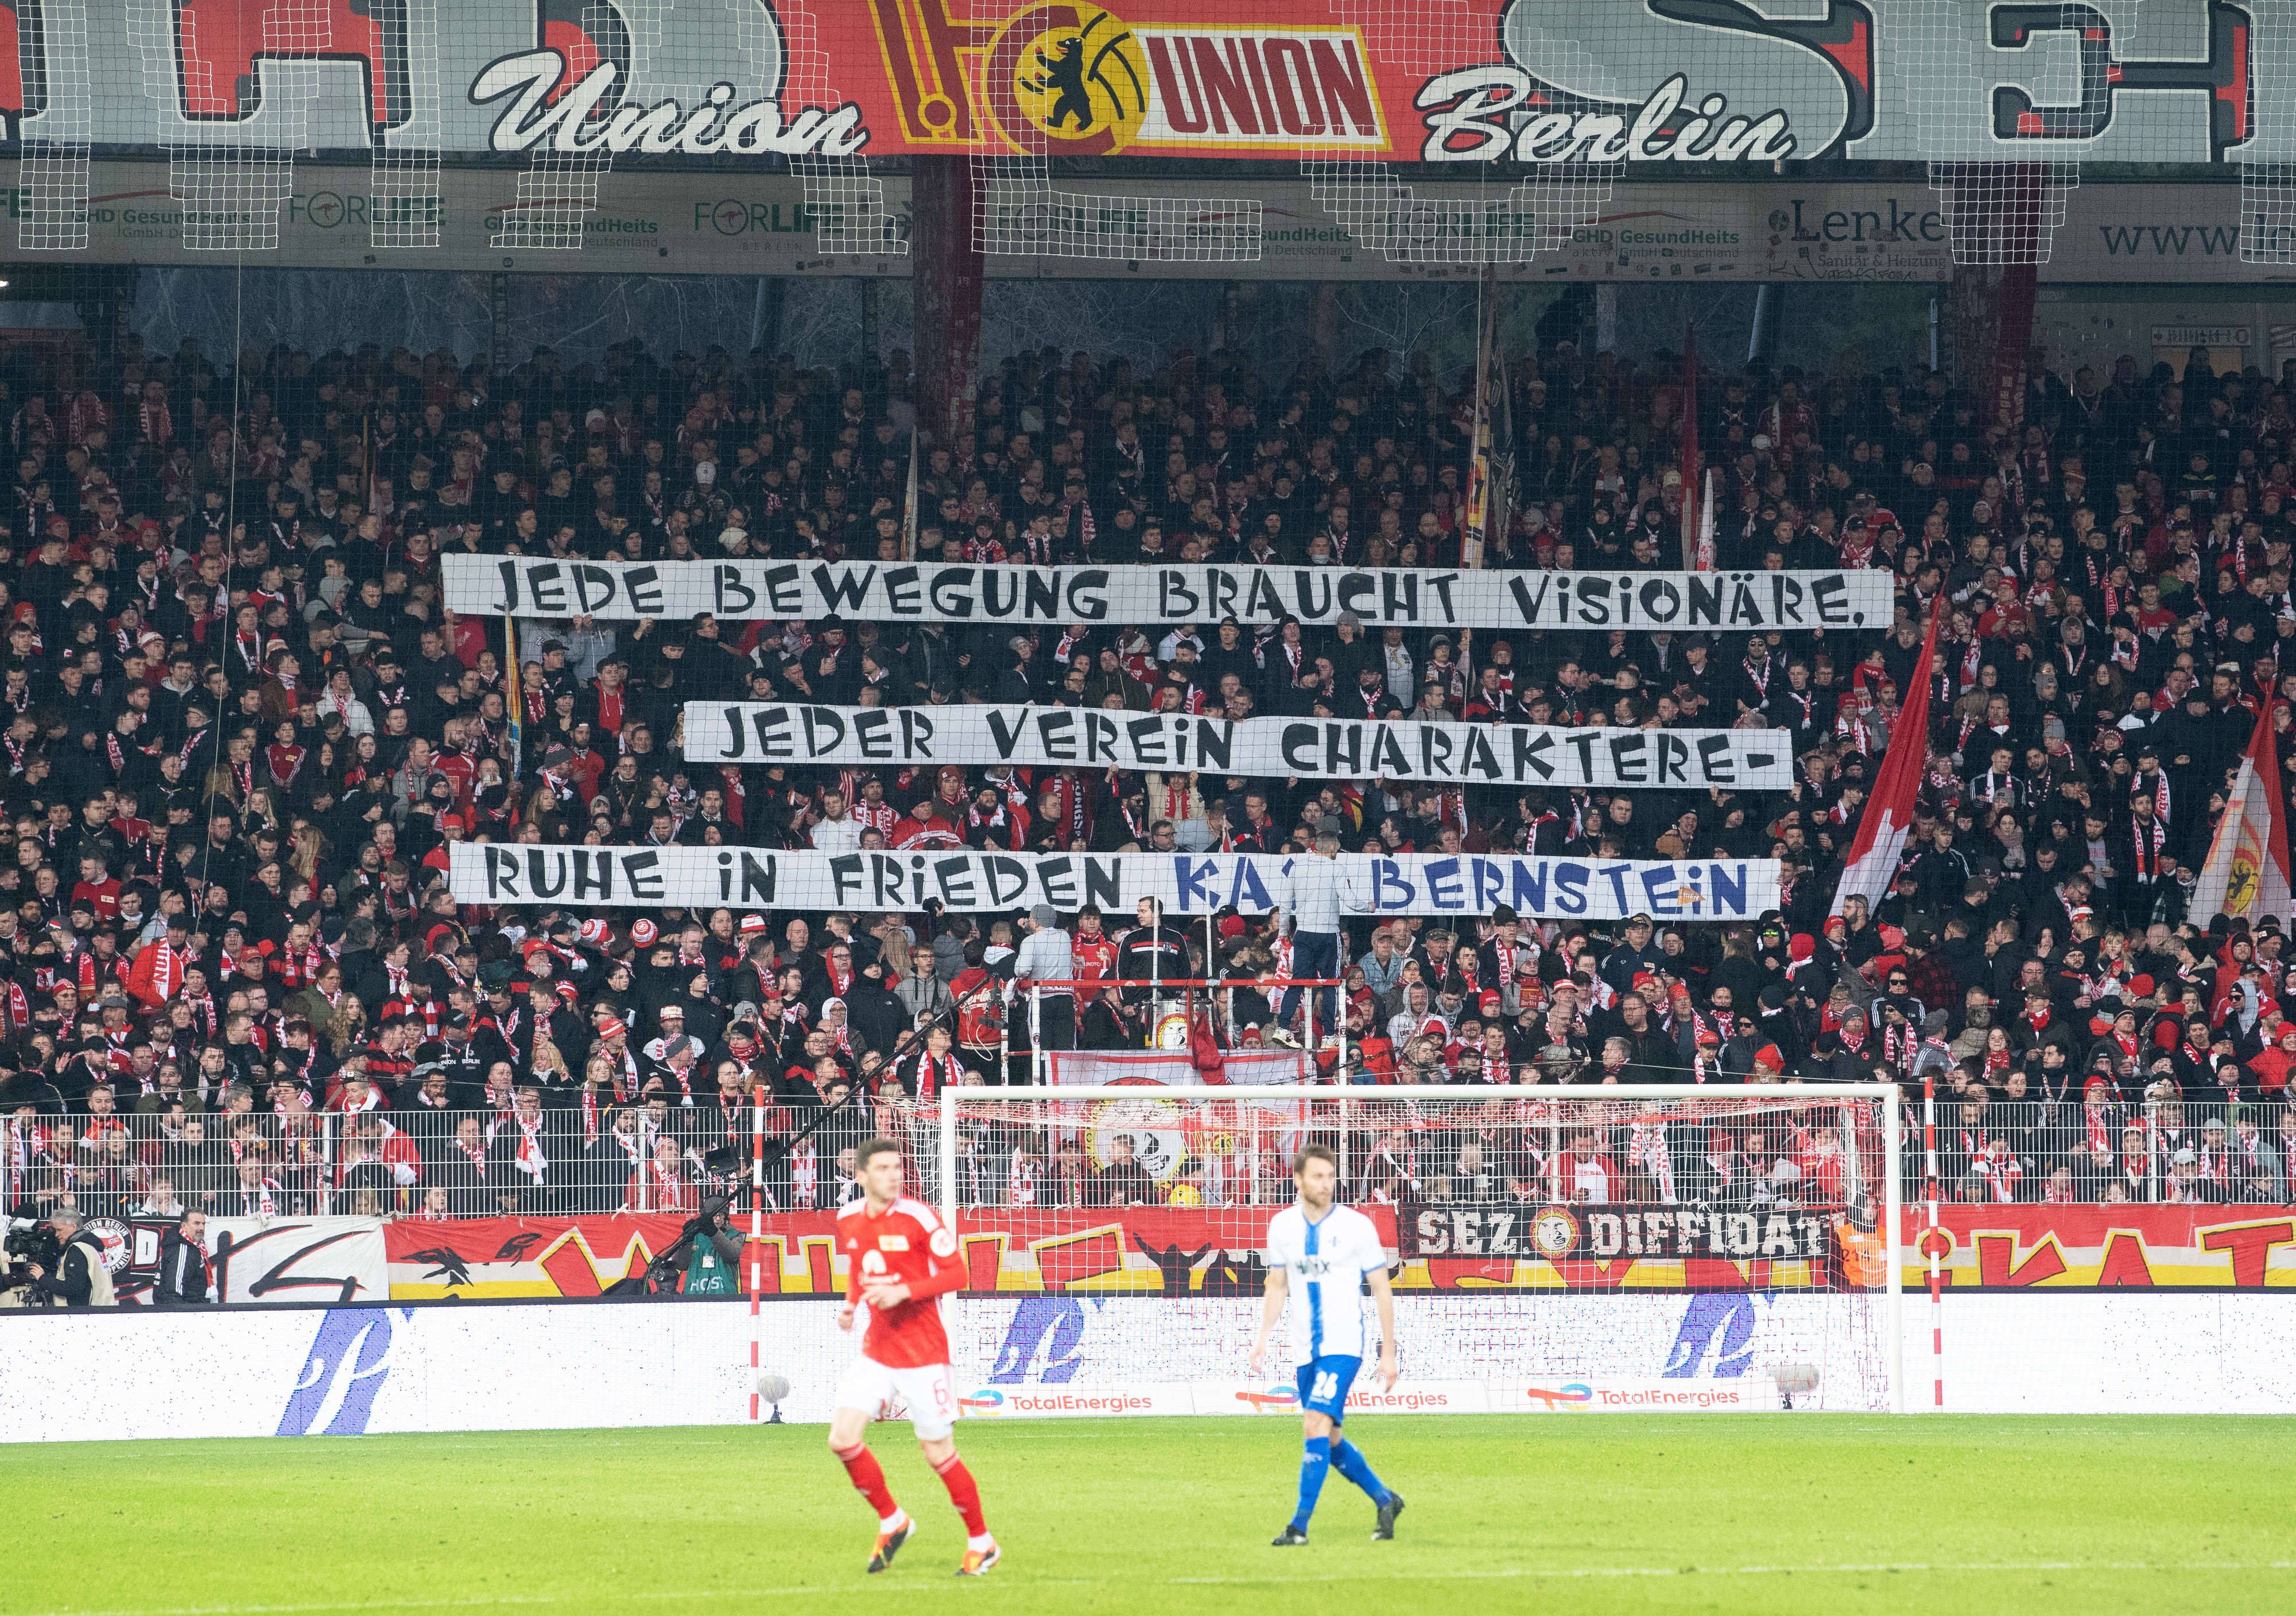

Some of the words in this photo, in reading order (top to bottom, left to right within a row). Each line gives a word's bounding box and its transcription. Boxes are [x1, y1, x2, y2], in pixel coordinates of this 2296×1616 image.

[468, 48, 870, 155] Union
[1145, 37, 1378, 136] UNION
[1414, 65, 1797, 161] Berlin
[1572, 229, 1613, 244] GHD
[1620, 229, 1740, 244] GesundHeits
[1791, 199, 1945, 242] Lenke
[1887, 254, 1947, 270] Heizung
[494, 560, 664, 613] JEDE
[714, 562, 1111, 620] BEWEGUNG
[1159, 568, 1459, 623] BRAUCHT
[720, 705, 933, 758] JEDER
[1281, 722, 1775, 784] CHARAKTERE-
[484, 846, 665, 900] RUHE
[1174, 856, 1296, 911] KA
[1009, 1394, 1153, 1412] TotalEnergies
[1597, 1388, 1740, 1407] TotalEnergies
